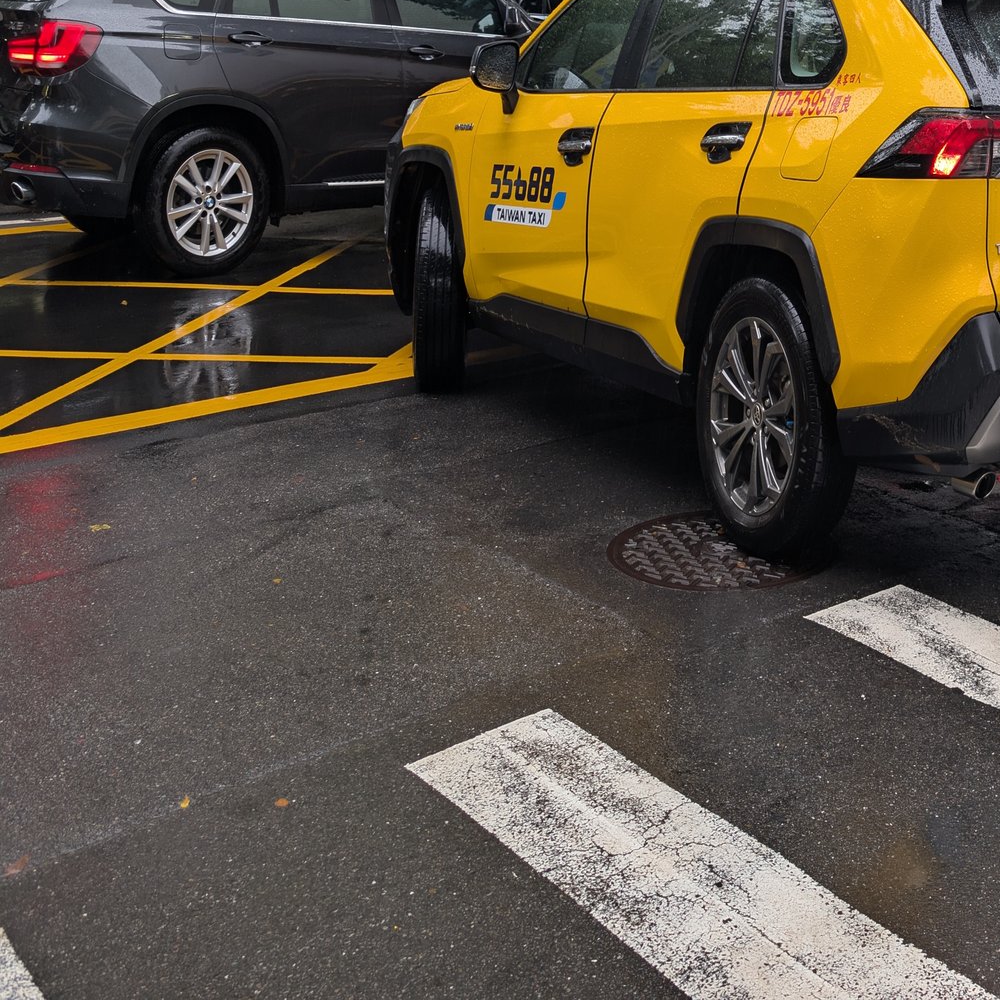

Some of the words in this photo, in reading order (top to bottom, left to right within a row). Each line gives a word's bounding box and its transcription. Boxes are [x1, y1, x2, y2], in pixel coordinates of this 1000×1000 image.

[490, 164, 555, 203] 55688
[497, 208, 526, 223] TAIWAN
[528, 211, 546, 225] TAXI
